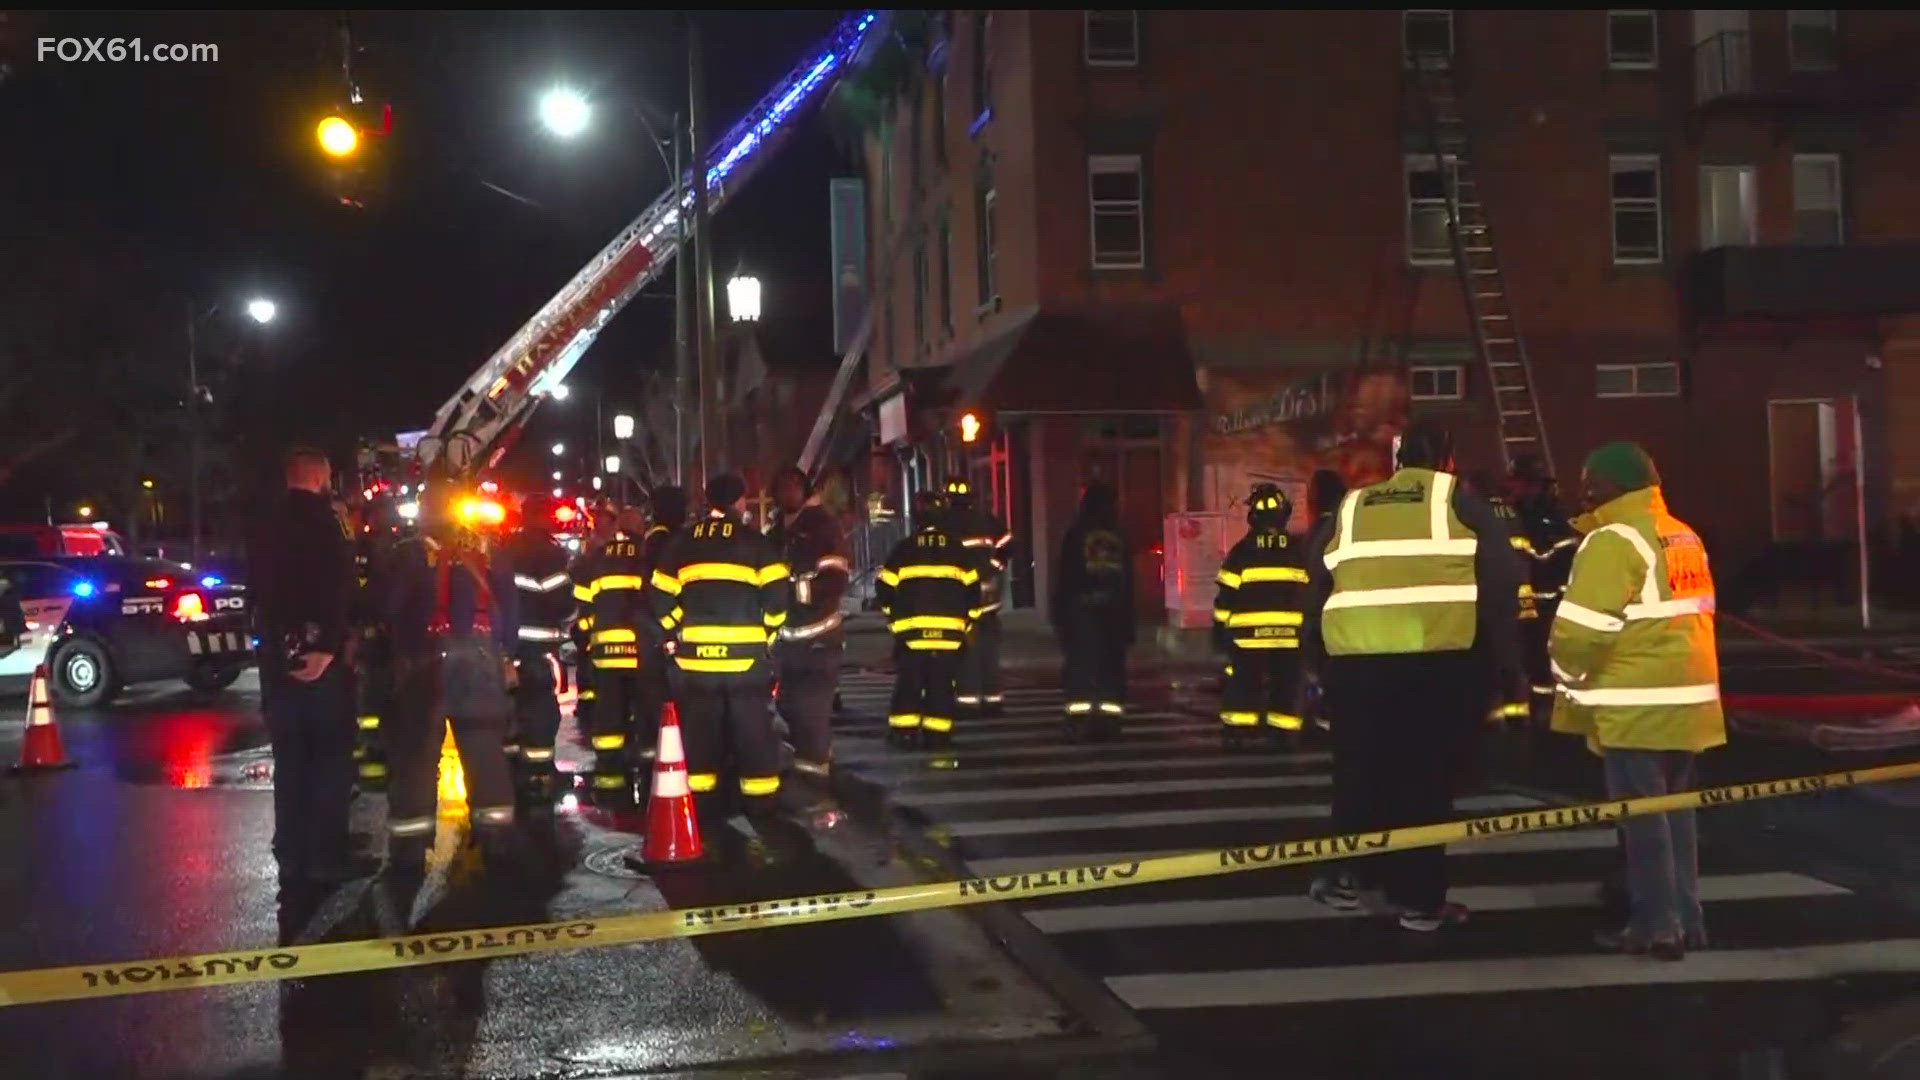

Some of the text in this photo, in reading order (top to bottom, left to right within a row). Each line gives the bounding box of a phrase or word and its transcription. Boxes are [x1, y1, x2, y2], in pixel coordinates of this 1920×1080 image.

[693, 523, 734, 539] HFD
[917, 534, 946, 547] HFD
[1257, 534, 1288, 549] HFD
[605, 542, 636, 557] HFD
[83, 954, 299, 988] CAUTION
[392, 923, 595, 959] CAUTION
[960, 861, 1140, 897] CAUTION
